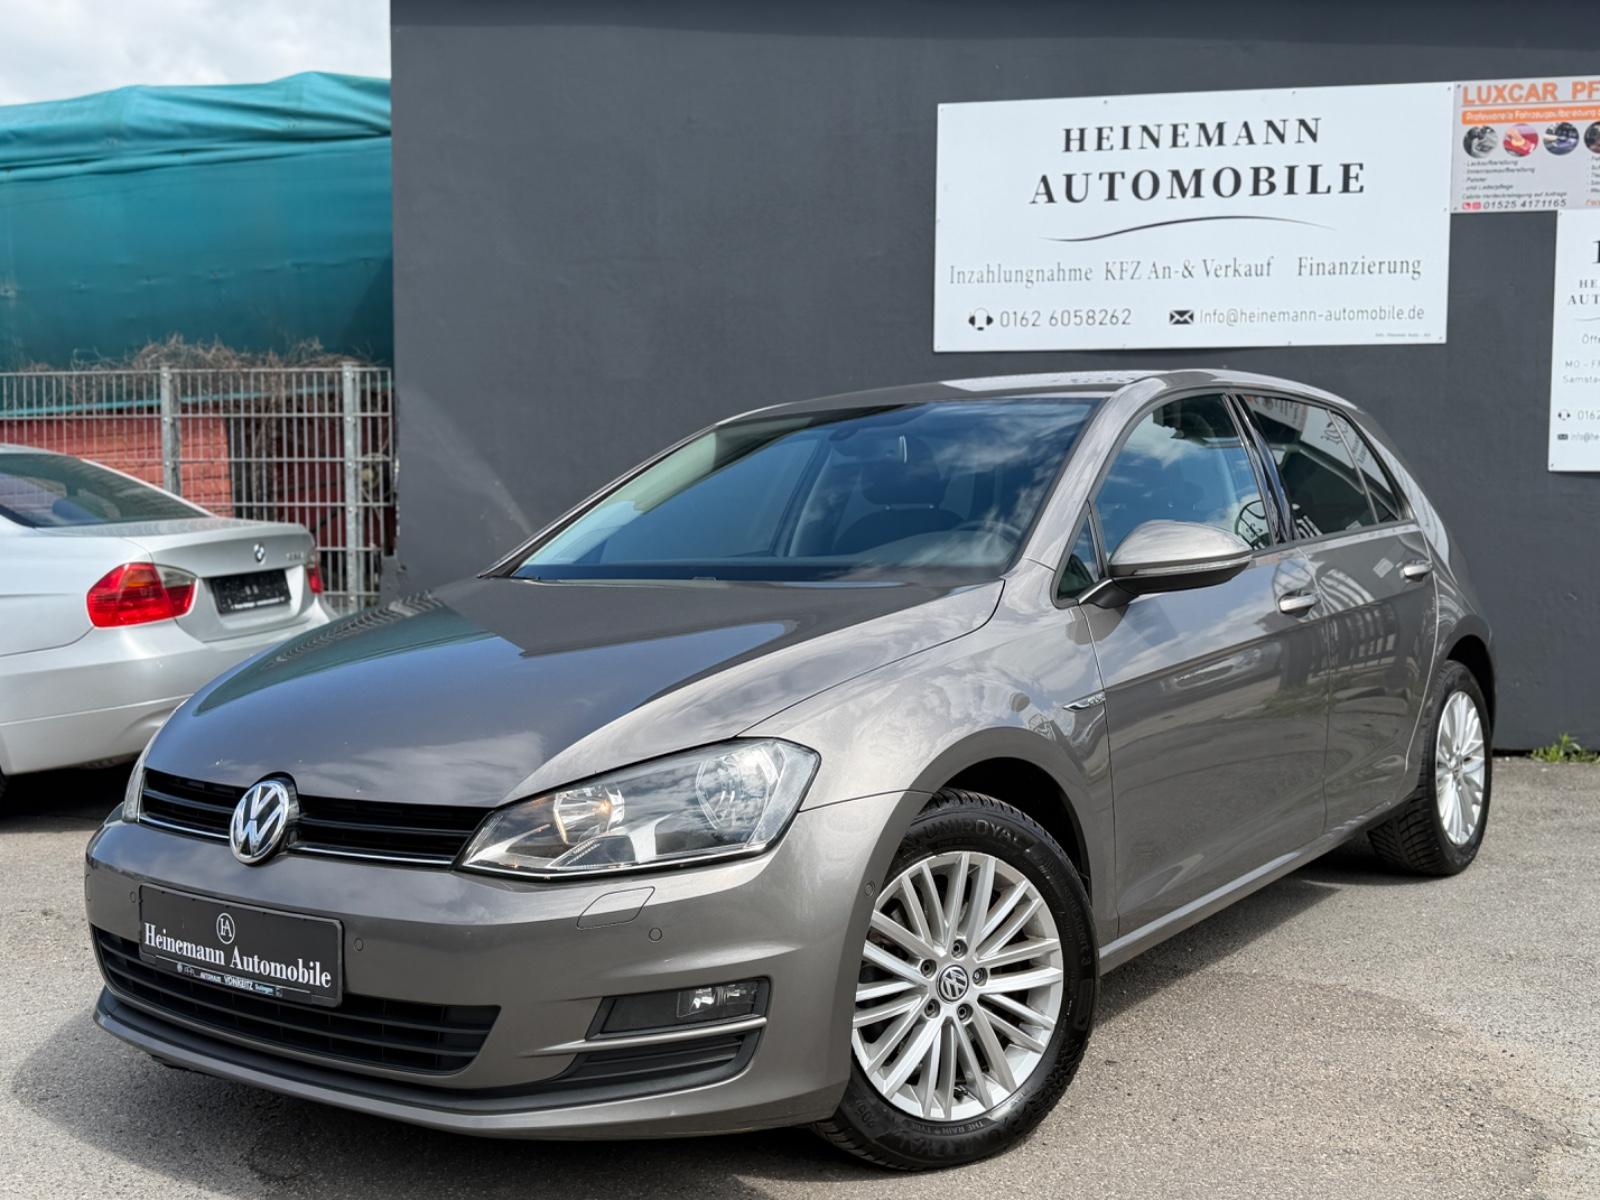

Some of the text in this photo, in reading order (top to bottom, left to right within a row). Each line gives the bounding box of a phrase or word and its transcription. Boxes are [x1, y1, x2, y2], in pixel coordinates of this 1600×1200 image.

[1463, 82, 1558, 105] LUXCAR
[1062, 117, 1322, 153] HEINEMANN
[1029, 162, 1366, 205] AUTOMOBILE
[1483, 198, 1568, 210] 01525 4171165
[949, 261, 1094, 289] Inzahlungnahme
[1104, 260, 1142, 281] KFZ
[1202, 256, 1275, 279] Verkauf
[1297, 256, 1423, 281] Finanzierung
[999, 307, 1132, 328] 0162 6058262
[1200, 304, 1425, 327] Info@heinemann-automobile.de
[144, 922, 225, 966] Heinemann
[230, 945, 332, 988] Automobile
